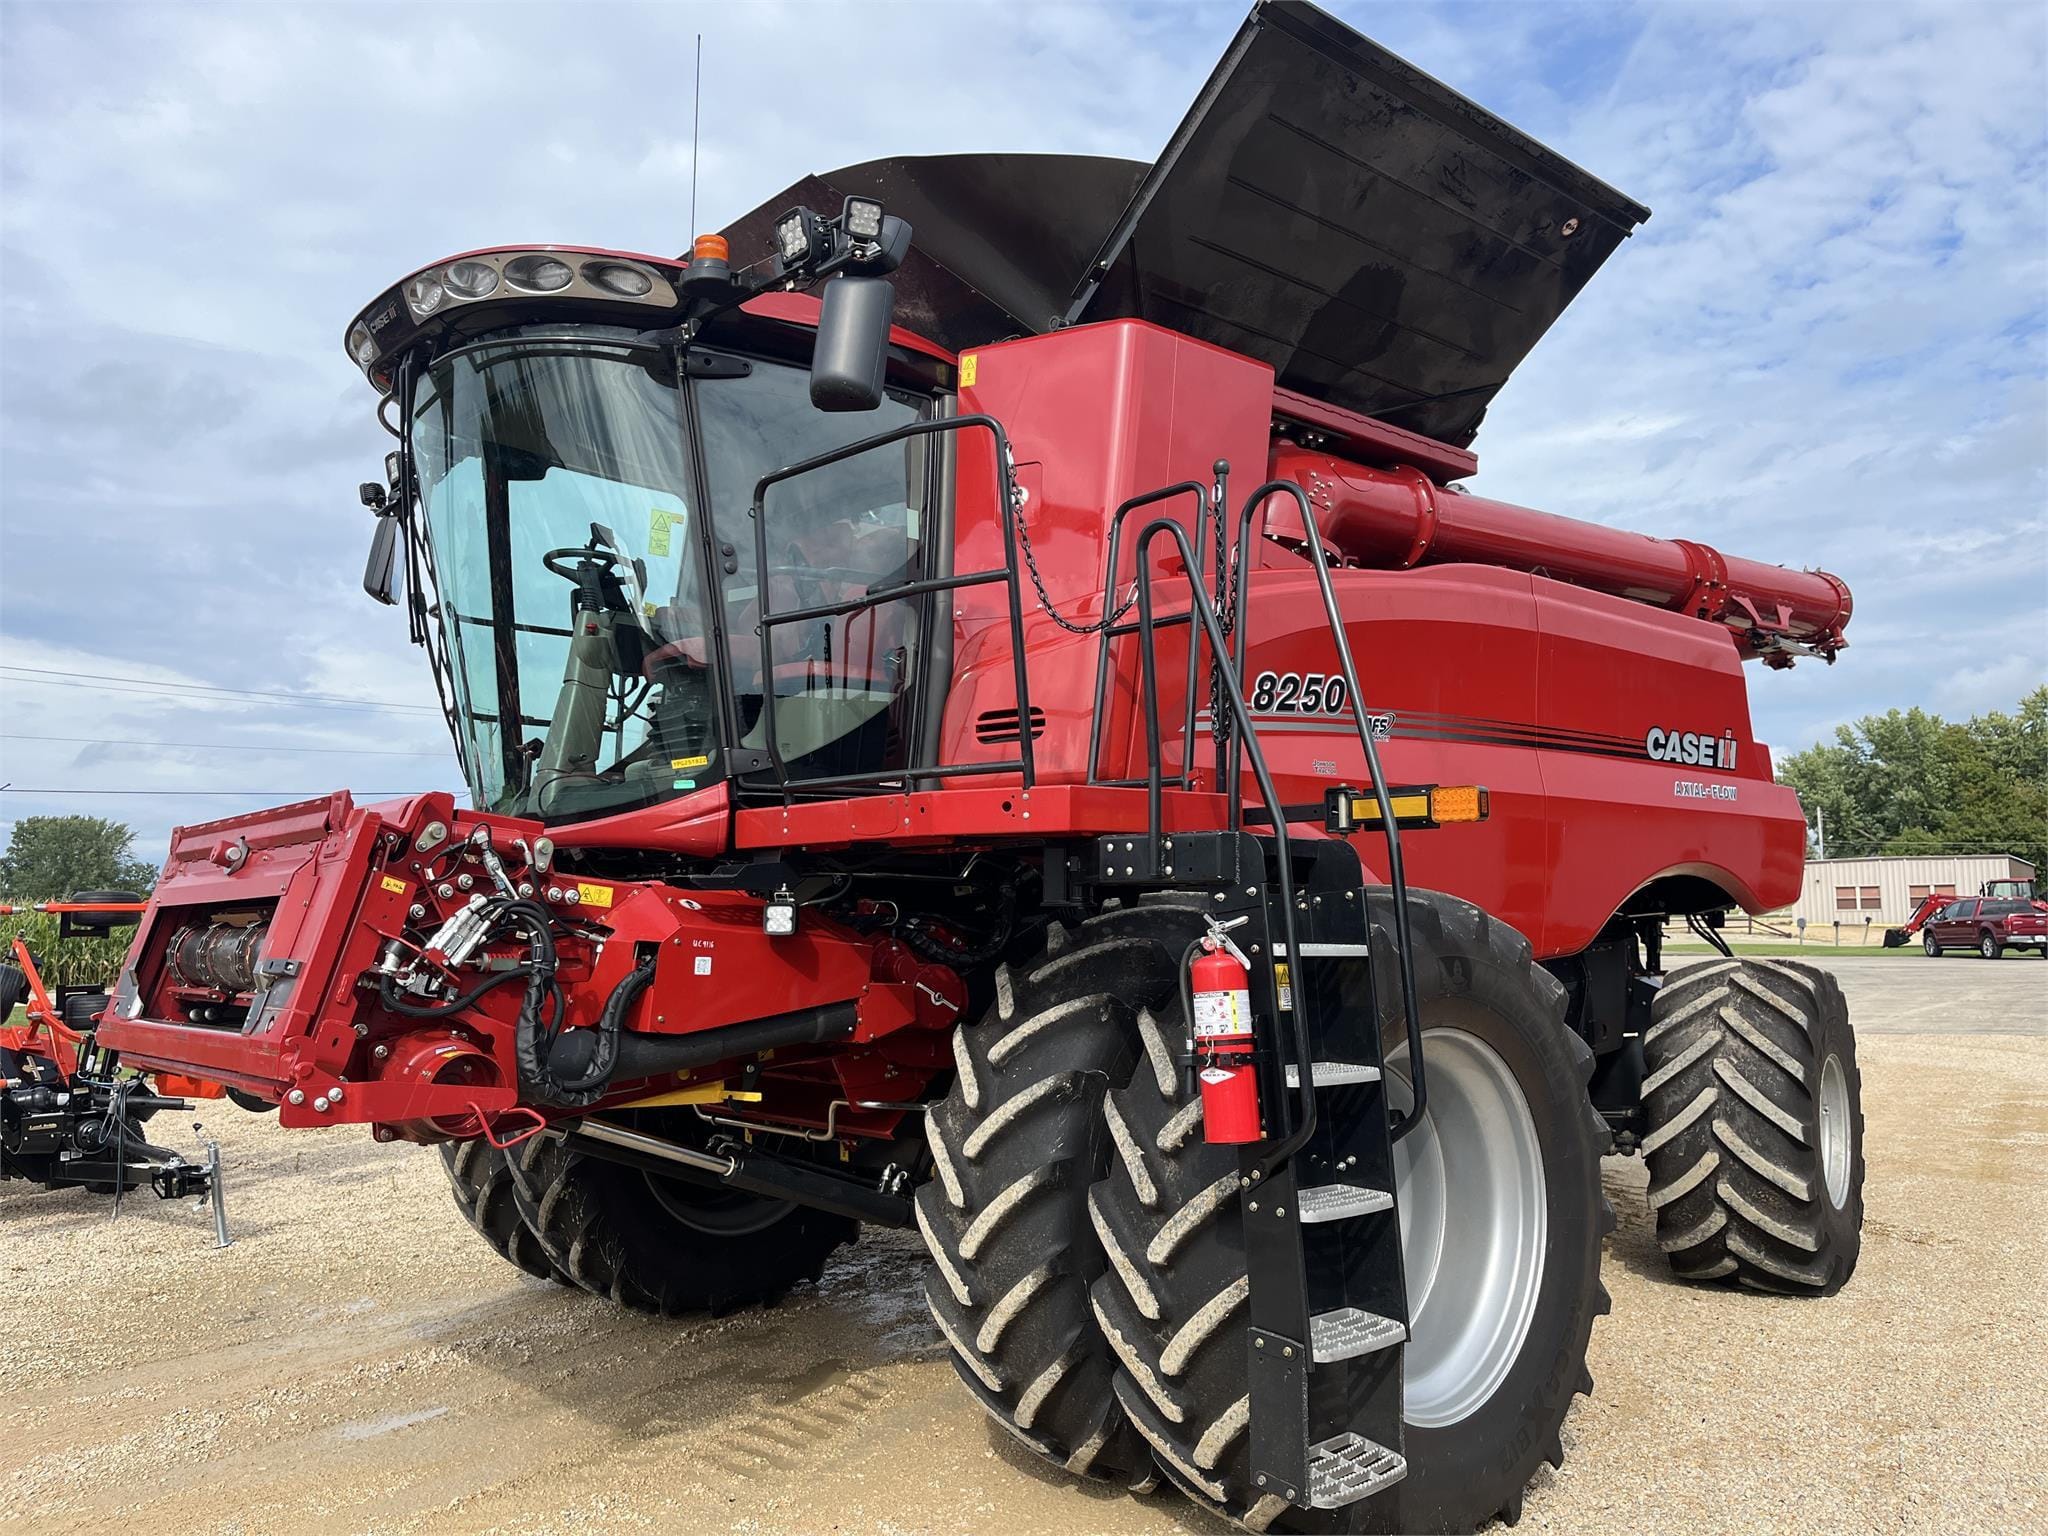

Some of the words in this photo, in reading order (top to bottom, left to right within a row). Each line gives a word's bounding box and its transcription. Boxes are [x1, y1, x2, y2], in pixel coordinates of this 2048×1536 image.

[1251, 671, 1347, 715] 8250
[1647, 727, 1715, 767] CASE
[1674, 781, 1737, 801] AXIAL-FLOW
